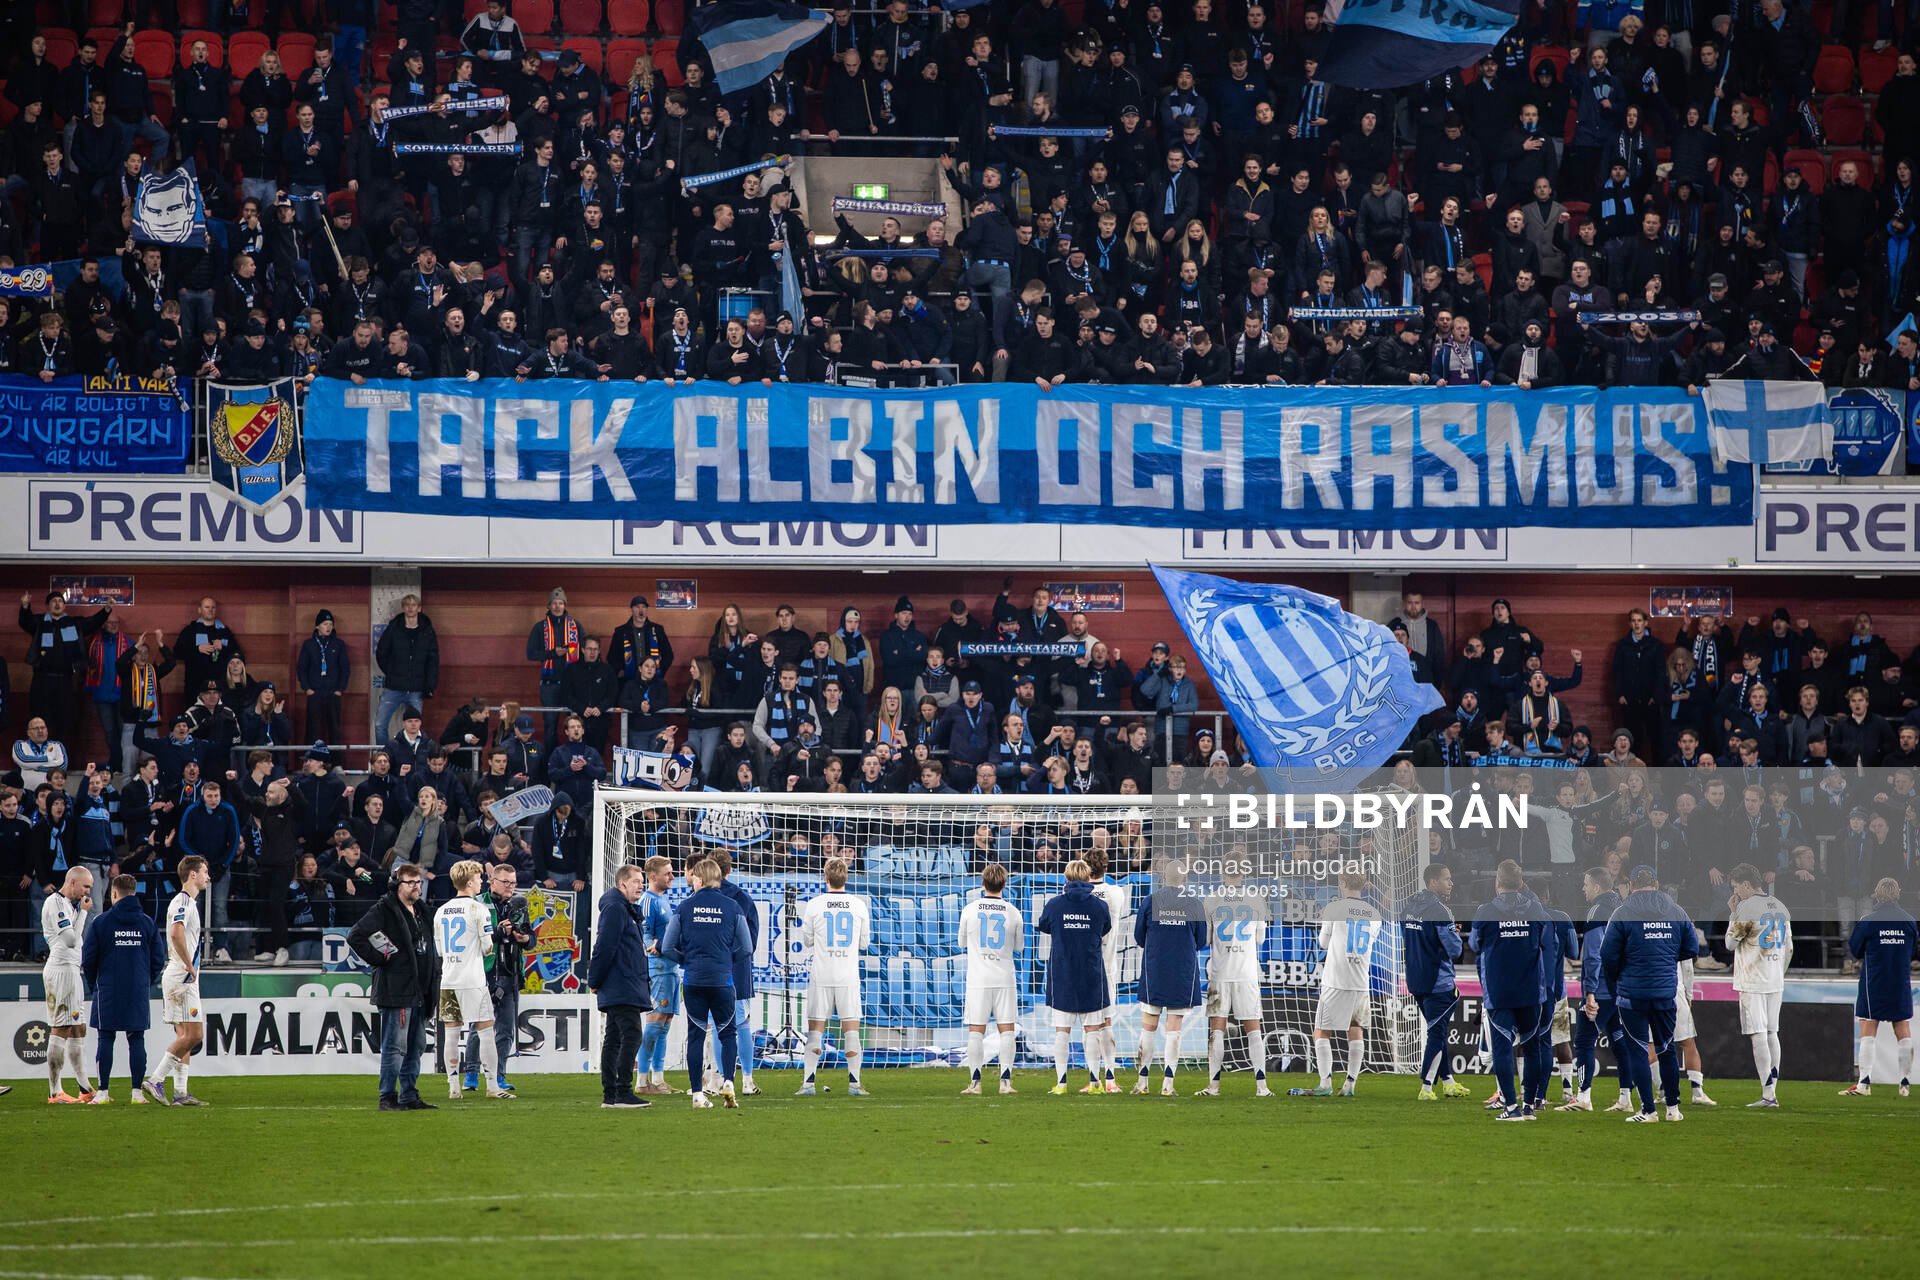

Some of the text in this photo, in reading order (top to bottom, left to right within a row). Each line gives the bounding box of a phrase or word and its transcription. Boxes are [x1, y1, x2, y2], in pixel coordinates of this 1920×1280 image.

[20, 268, 47, 292] 29
[344, 387, 637, 502] TACK
[673, 395, 1000, 504] ALBIN
[1035, 399, 1244, 512] OCH
[1765, 502, 1920, 552] PRE
[693, 906, 723, 915] MOBILL
[1159, 909, 1187, 917] MOBILL
[692, 915, 722, 924] stadium
[1063, 913, 1091, 921] MOBILL
[1063, 922, 1091, 930] stadium
[1215, 904, 1254, 942] 22
[1499, 920, 1530, 929] MOBILL
[1643, 921, 1673, 930] MOBILL
[114, 930, 143, 938] MOBILL
[440, 916, 466, 953] 12
[823, 911, 853, 949] 19
[977, 911, 1007, 950] 13
[1499, 929, 1530, 938] stadium
[1879, 929, 1905, 937] MOBILL
[1345, 917, 1371, 955] 16
[1643, 931, 1672, 940] stadium
[189, 1001, 382, 1057] MÅLAN
